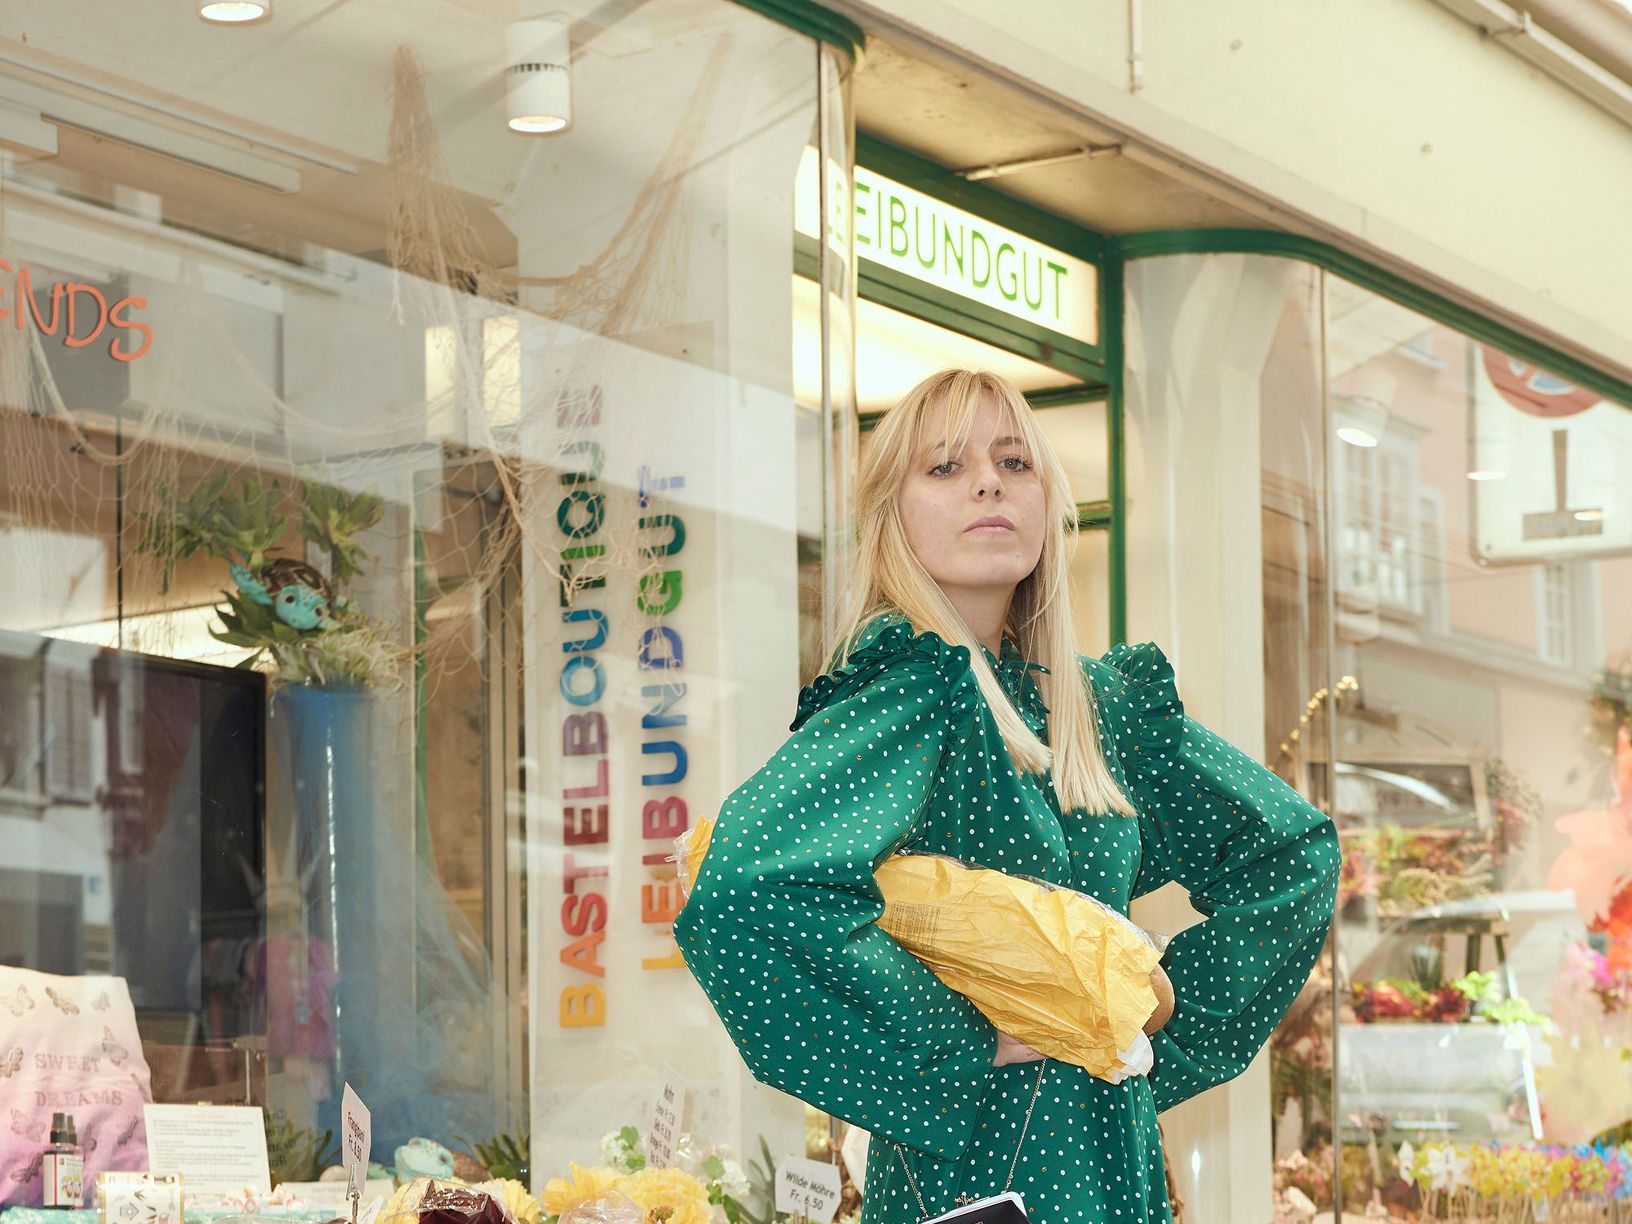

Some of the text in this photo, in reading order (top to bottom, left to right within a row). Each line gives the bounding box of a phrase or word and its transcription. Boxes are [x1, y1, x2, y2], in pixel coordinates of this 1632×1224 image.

[828, 180, 1069, 320] EIBUNDGUT
[556, 384, 610, 1028] BASTELBOUTIQUE
[35, 1053, 101, 1073] SWEET
[785, 1170, 808, 1189] Wilde
[790, 1189, 824, 1210] Fr. 6.50
